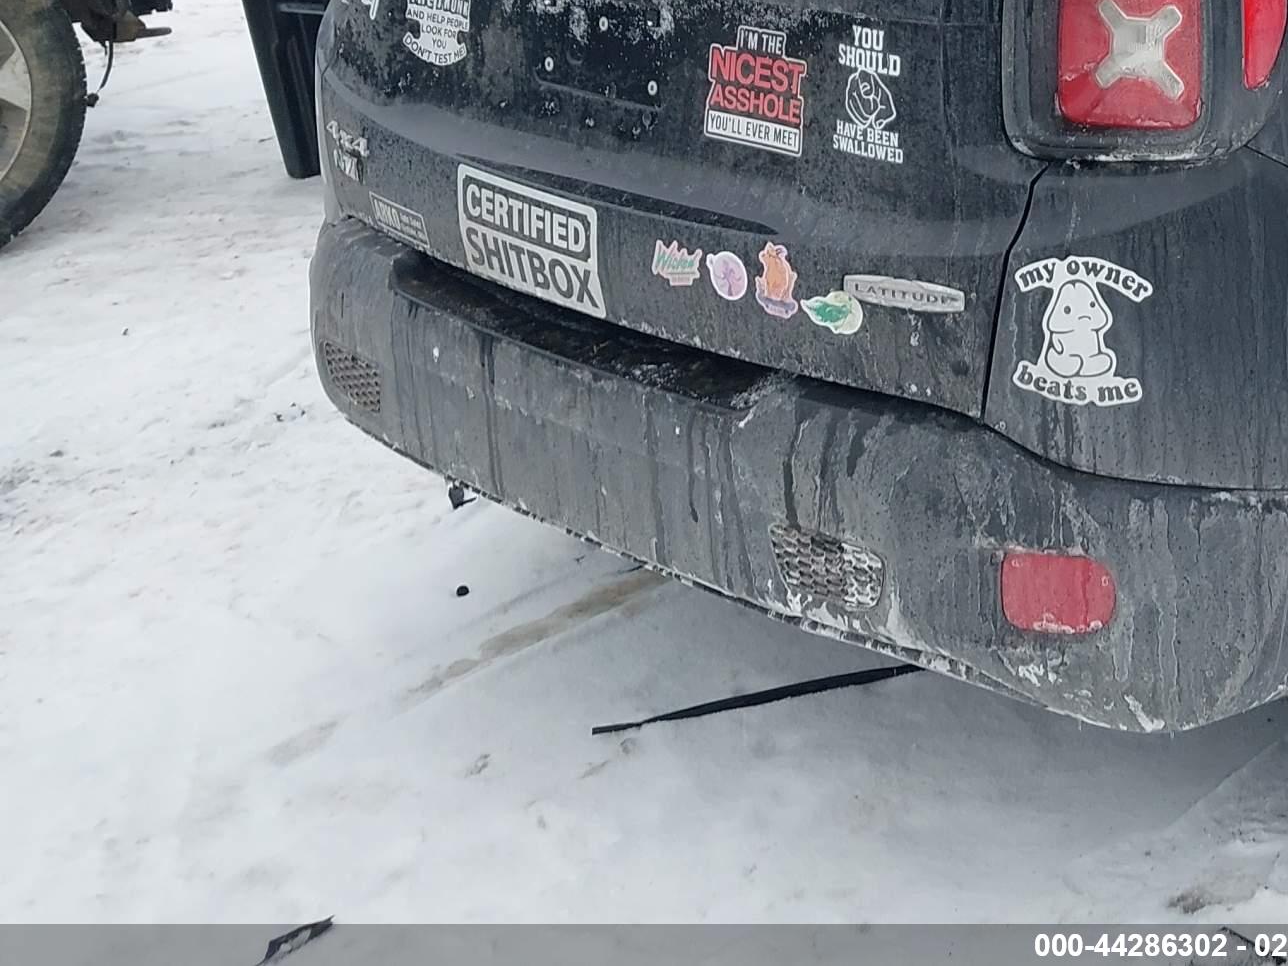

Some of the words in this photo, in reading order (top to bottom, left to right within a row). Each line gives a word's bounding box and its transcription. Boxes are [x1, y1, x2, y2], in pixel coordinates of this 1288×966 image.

[407, 8, 425, 21] AND
[426, 13, 446, 25] HELP
[446, 17, 468, 30] PEOPLE
[420, 23, 442, 35] LOOK
[443, 29, 457, 40] FOR
[404, 34, 433, 61] DON'T
[434, 52, 454, 64] TEST
[431, 38, 448, 50] YOU
[740, 32, 758, 51] I'M
[762, 34, 783, 54] THE
[852, 25, 885, 51] YOU
[711, 46, 805, 94] NICEST
[838, 44, 902, 77] SHOULD
[709, 85, 802, 125] ASSHOLE
[709, 113, 742, 136] YOU'LL
[746, 122, 771, 141] EVER
[773, 129, 799, 151] MEET
[836, 119, 864, 141] HAVE
[866, 128, 899, 147] BEEN
[832, 135, 904, 164] SWALLOWED
[465, 183, 588, 253] CERTIFIED
[464, 227, 600, 309] SHITBOX
[1019, 261, 1057, 288] my
[1066, 260, 1149, 298] owner
[1016, 365, 1087, 401] beats
[1097, 382, 1139, 402] me
